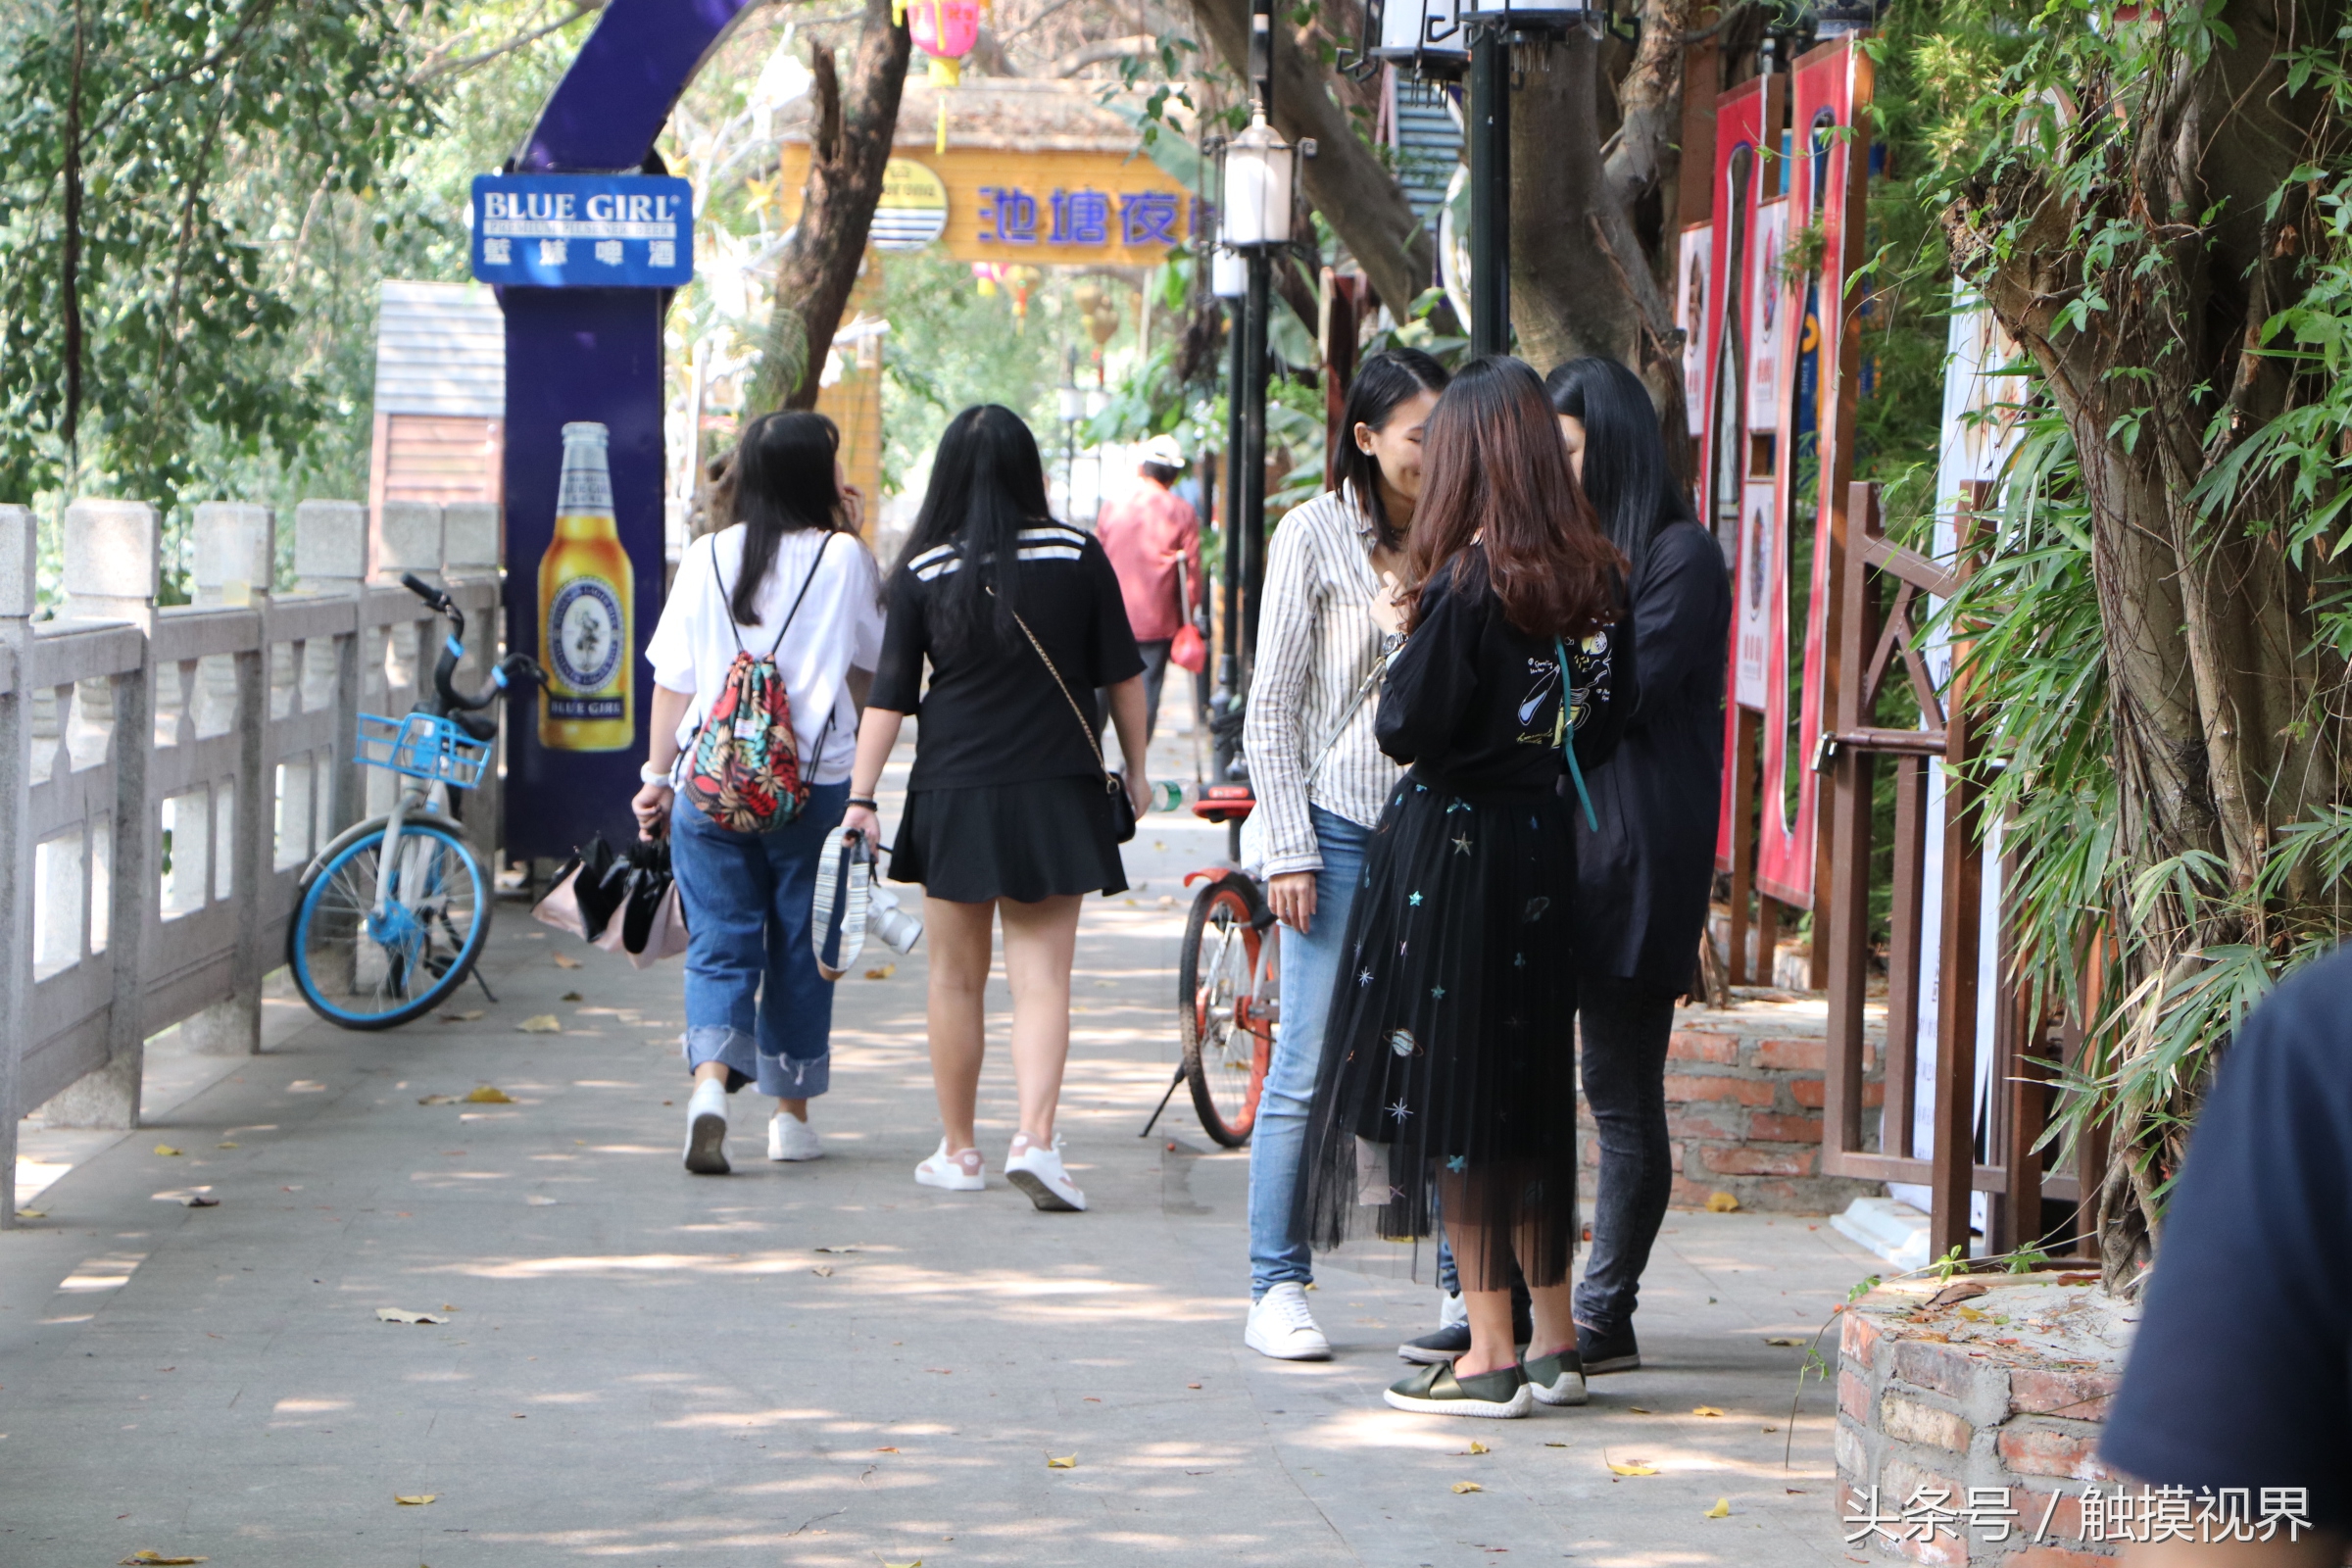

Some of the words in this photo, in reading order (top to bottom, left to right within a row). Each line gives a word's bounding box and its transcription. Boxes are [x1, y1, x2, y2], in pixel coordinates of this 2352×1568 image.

[483, 192, 577, 220] BLUE
[586, 194, 676, 222] GIRL
[551, 701, 585, 714] BLUE
[588, 701, 621, 715] GIRL
